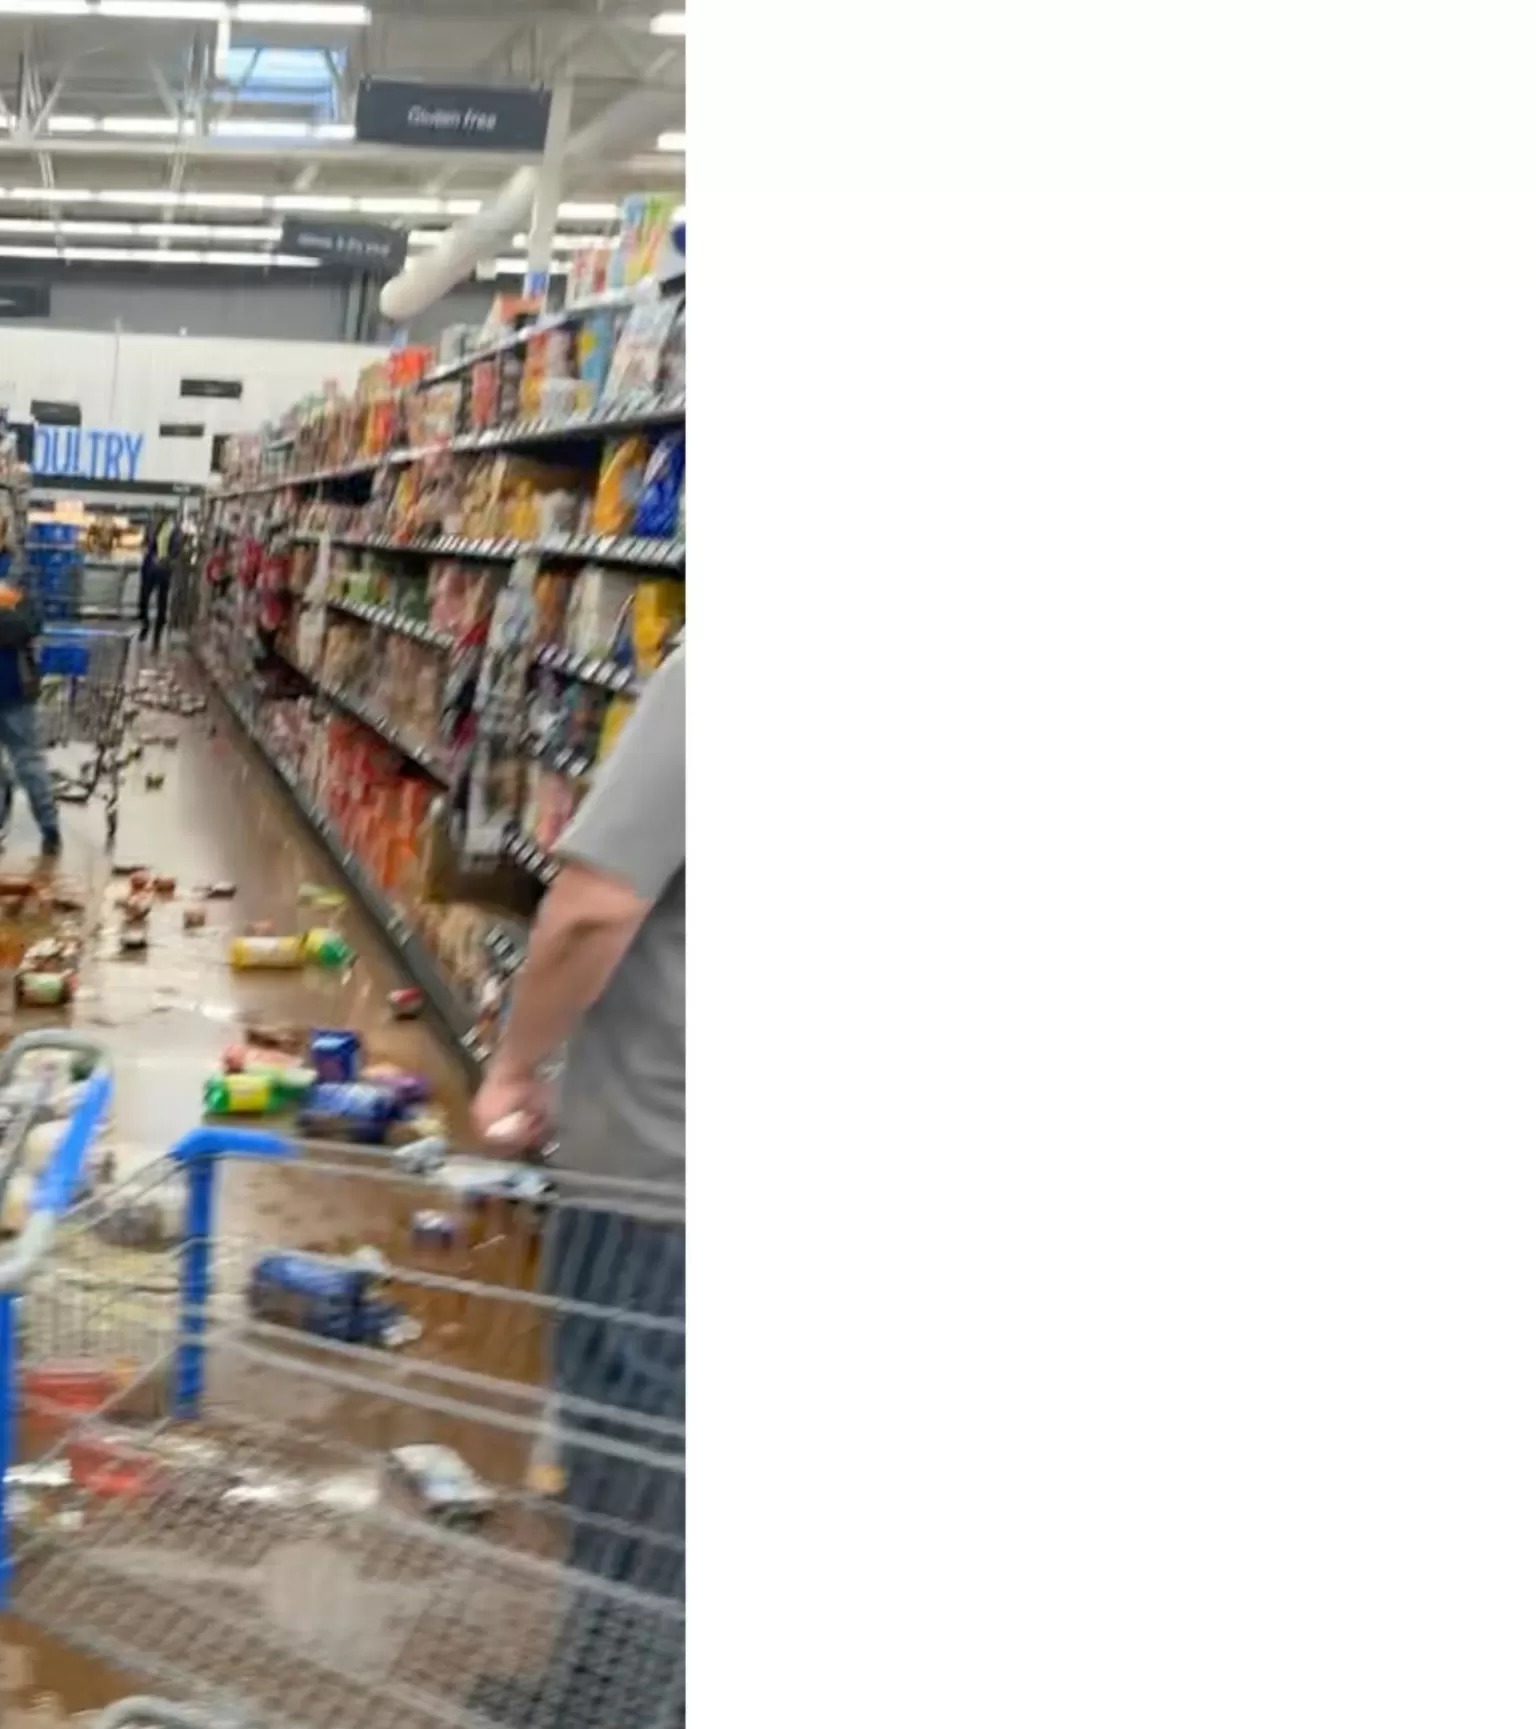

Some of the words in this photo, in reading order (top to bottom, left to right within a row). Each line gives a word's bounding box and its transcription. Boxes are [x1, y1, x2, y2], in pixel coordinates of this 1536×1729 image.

[407, 104, 461, 130] Gluten
[463, 106, 497, 132] free
[33, 425, 145, 482] OULTRY
